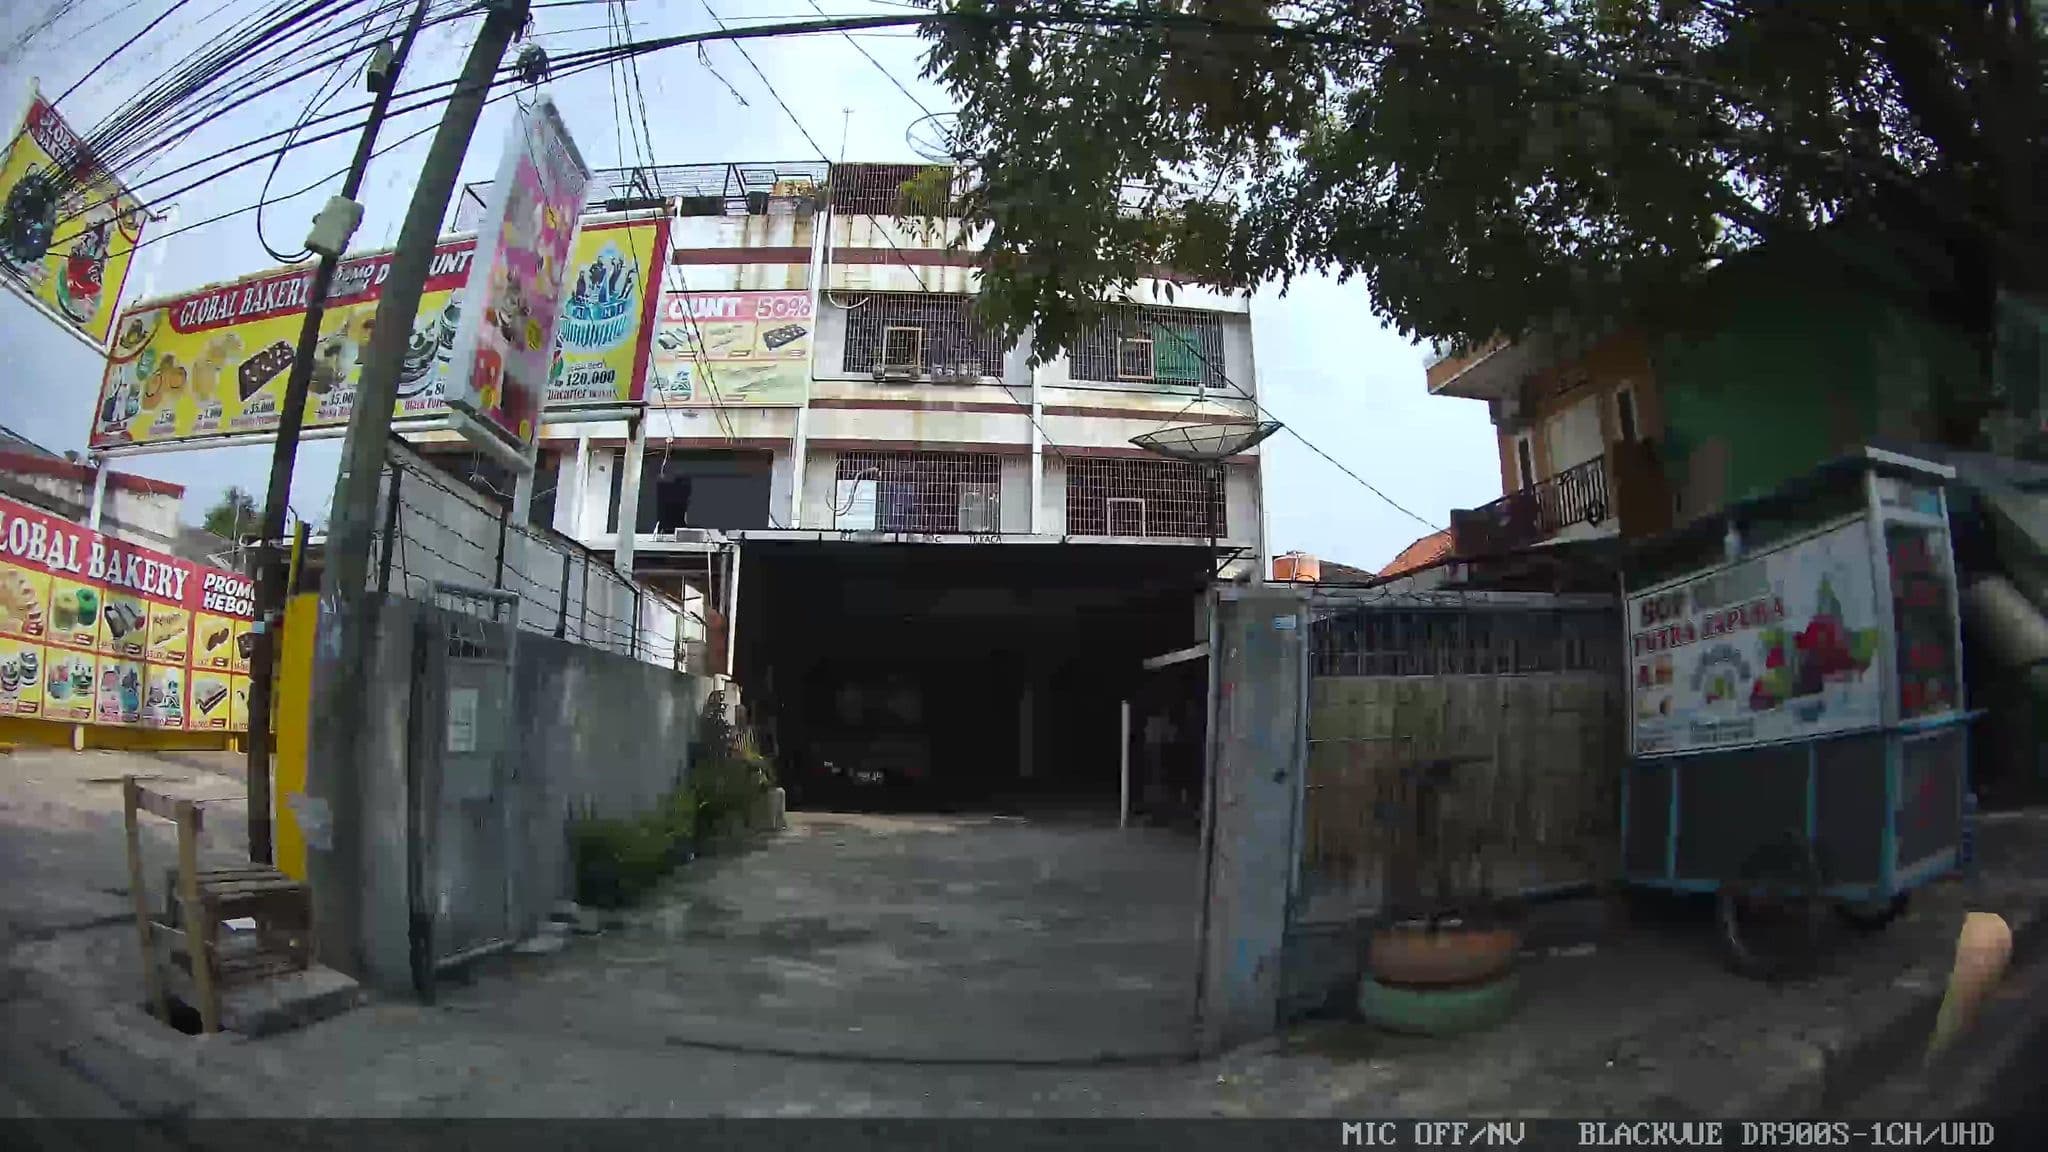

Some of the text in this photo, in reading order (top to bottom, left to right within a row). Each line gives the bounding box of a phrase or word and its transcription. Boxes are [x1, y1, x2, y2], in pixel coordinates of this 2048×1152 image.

[180, 290, 240, 328] GLOBAL
[755, 294, 813, 320] 50%
[566, 369, 616, 387] 120.000
[88, 542, 190, 601] BAKERY
